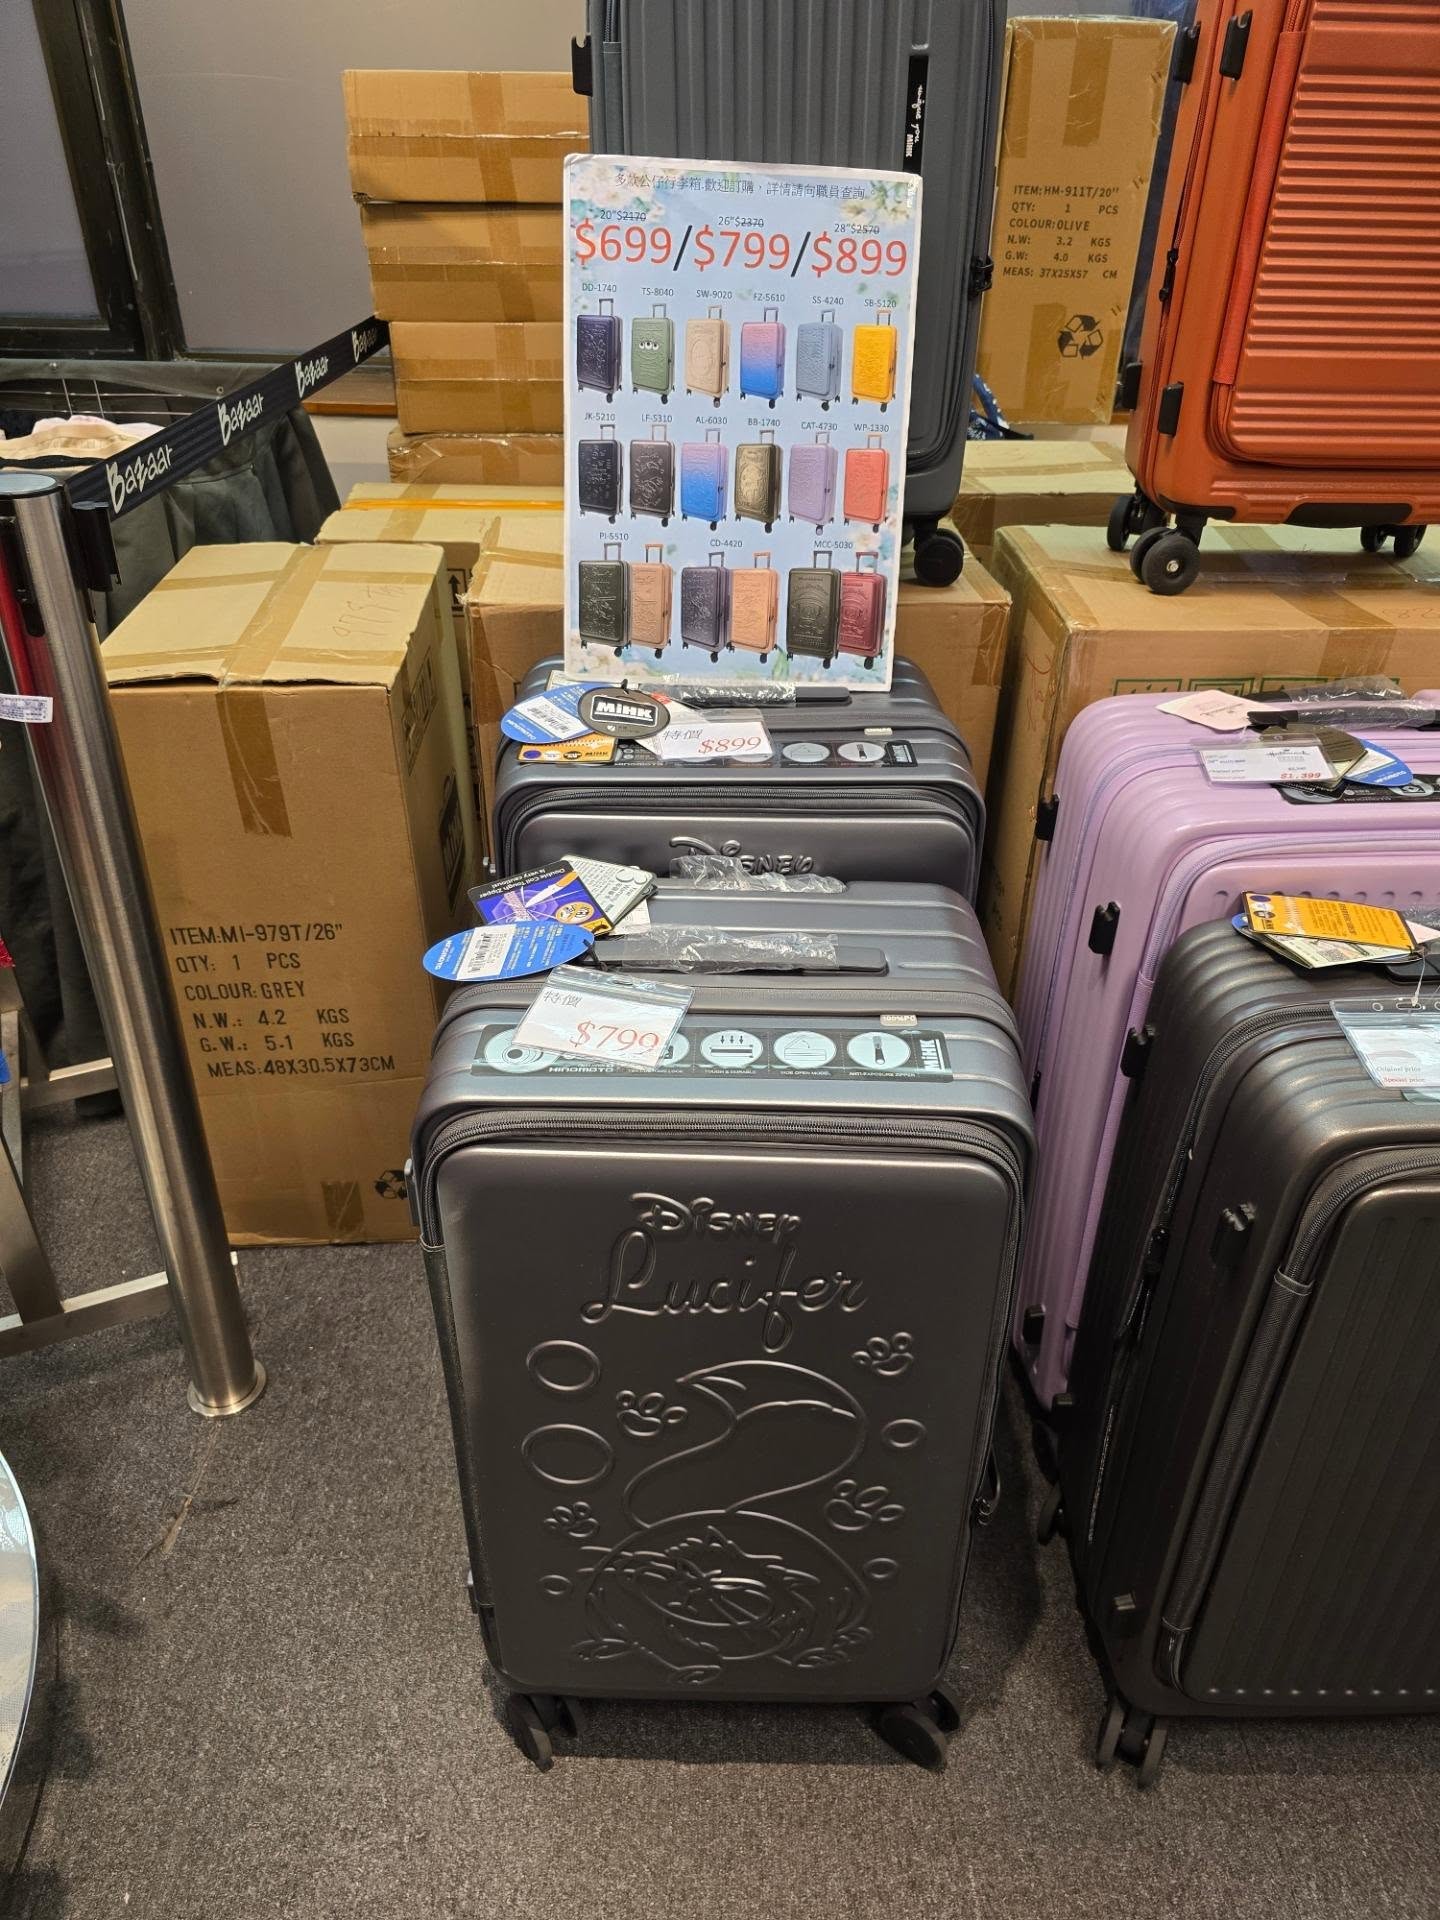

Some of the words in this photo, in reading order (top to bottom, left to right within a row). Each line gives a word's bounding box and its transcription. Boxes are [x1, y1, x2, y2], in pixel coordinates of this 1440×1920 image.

[911, 123, 920, 143] you
[1011, 202, 1036, 213] QTY:
[1065, 203, 1071, 213] 1
[1098, 205, 1119, 215] PCS
[1007, 234, 1031, 245] N.W:
[1056, 236, 1073, 246] 3.2
[1090, 237, 1111, 248] KGS
[1005, 250, 1028, 261] G.W:
[1053, 252, 1069, 262] 4.0
[1087, 253, 1108, 264] KGS
[1002, 267, 1034, 277] MEAS:
[1039, 267, 1088, 279] 37X25X57
[1102, 270, 1118, 279] CM
[582, 283, 617, 293] DD-1740
[642, 287, 674, 297] TS-8040
[696, 290, 732, 299] SW-9020
[753, 293, 785, 302] FZ-5610
[812, 296, 844, 305] SS-4240
[864, 299, 897, 308] SB-5120
[295, 356, 329, 398] Bazaar
[217, 392, 264, 447] Bazaar
[584, 412, 616, 421] JK-5210
[641, 414, 673, 423] LF-5310
[695, 416, 728, 425] AL-6030
[748, 418, 781, 427] BB-1740
[801, 422, 838, 431] CAT-4730
[854, 423, 890, 432] WP-1330
[106, 444, 173, 514] Bazaar
[599, 532, 629, 541] PI-5510
[710, 539, 743, 548] CD-4420
[814, 540, 853, 549] MCC-5030
[698, 736, 762, 754] $899
[176, 955, 216, 973] QTY:
[232, 954, 241, 971] 1
[266, 952, 301, 970] PCS
[257, 1009, 287, 1026] 4.2
[316, 1008, 350, 1025] KGS
[264, 1035, 294, 1051] 5.1
[321, 1032, 355, 1048] KGS
[569, 1020, 659, 1053] $799
[580, 1225, 869, 1353] Lucifer
